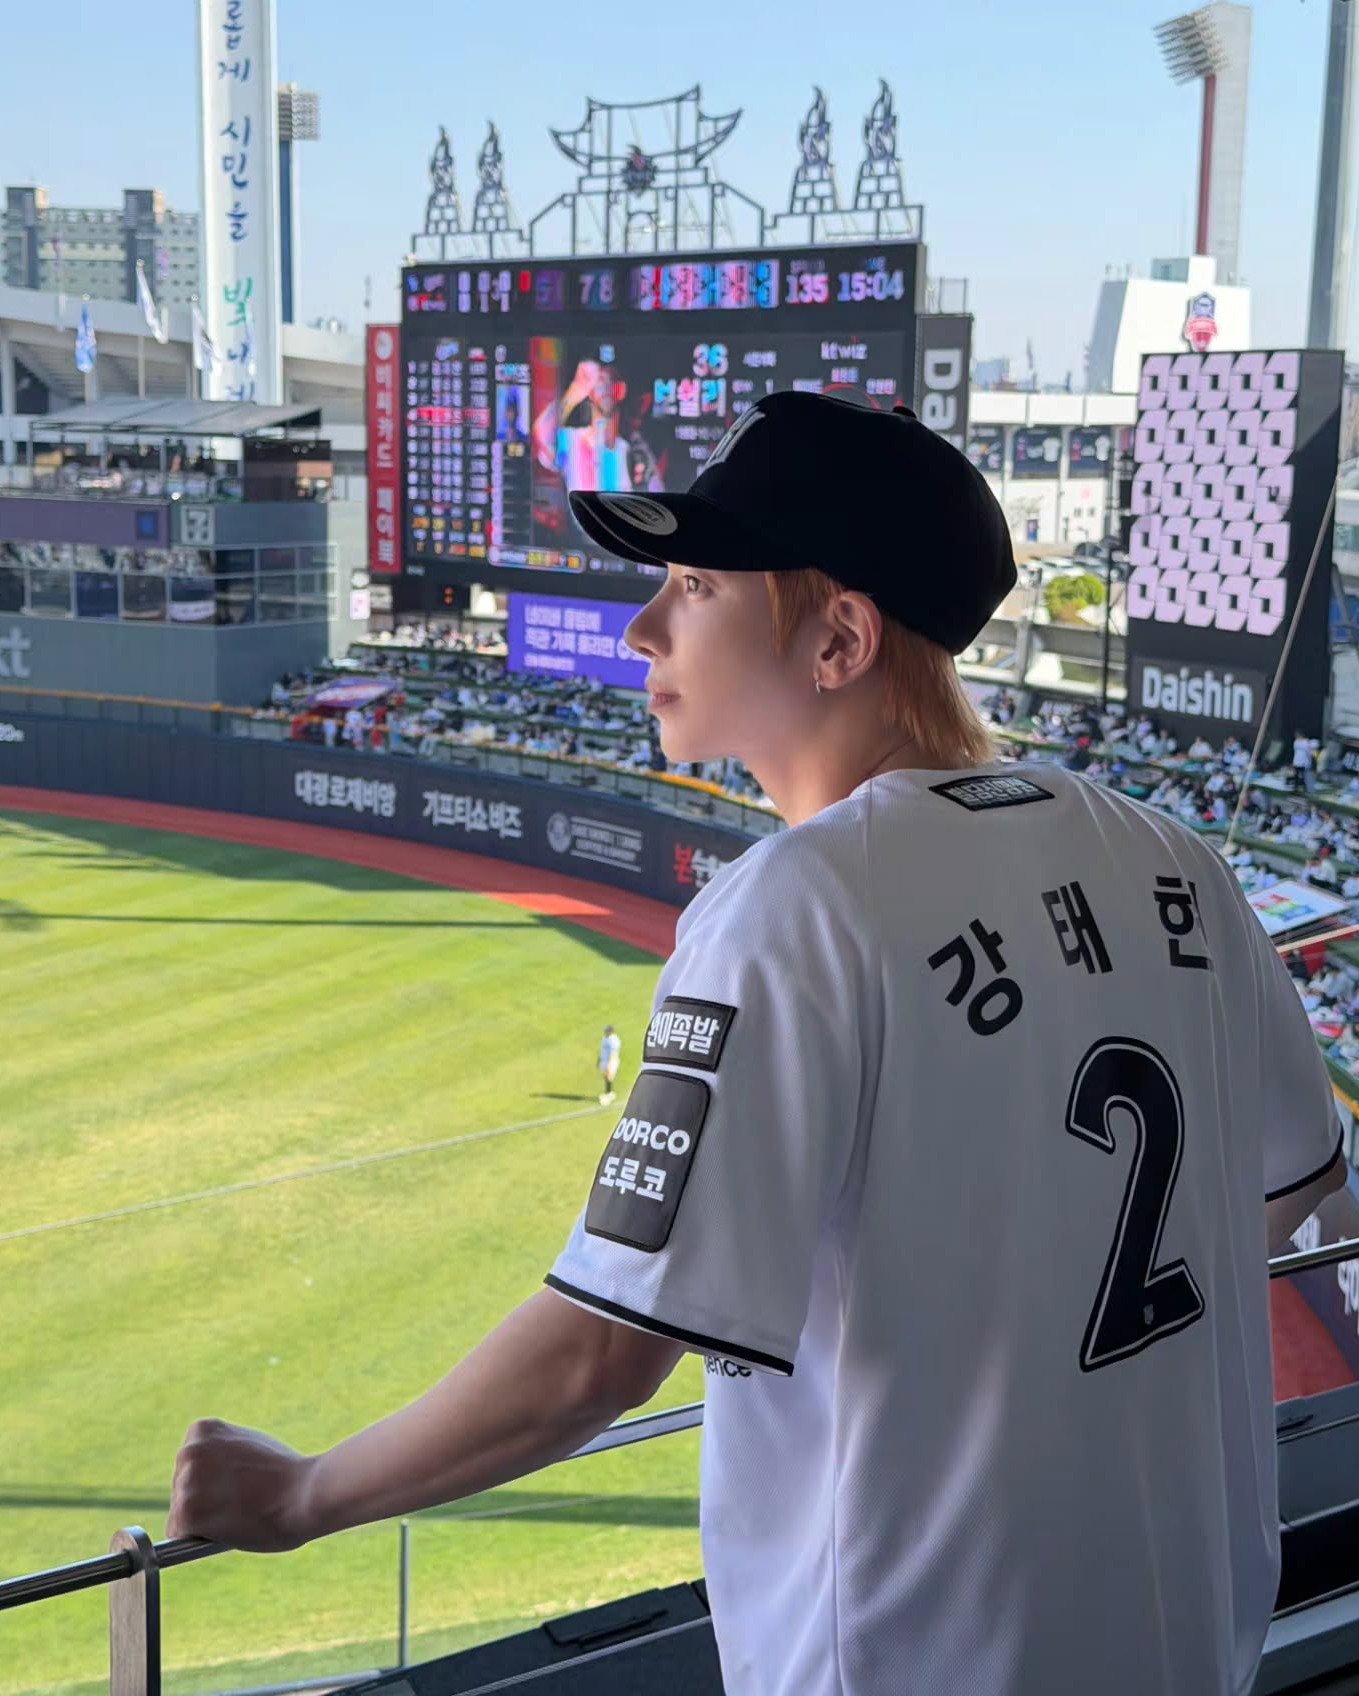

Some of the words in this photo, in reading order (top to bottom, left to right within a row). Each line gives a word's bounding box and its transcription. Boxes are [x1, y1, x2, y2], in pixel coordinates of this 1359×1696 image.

[220, 115, 251, 242] 시민을
[785, 272, 829, 304] 135
[838, 270, 904, 302] 15:04
[693, 344, 728, 377] 36
[1142, 665, 1253, 723] Daishin
[294, 770, 397, 818] 대광로제비앙
[422, 789, 523, 839] 기프티쇼비즈
[599, 1156, 668, 1202] 도루코
[1065, 1036, 1206, 1374] 2
